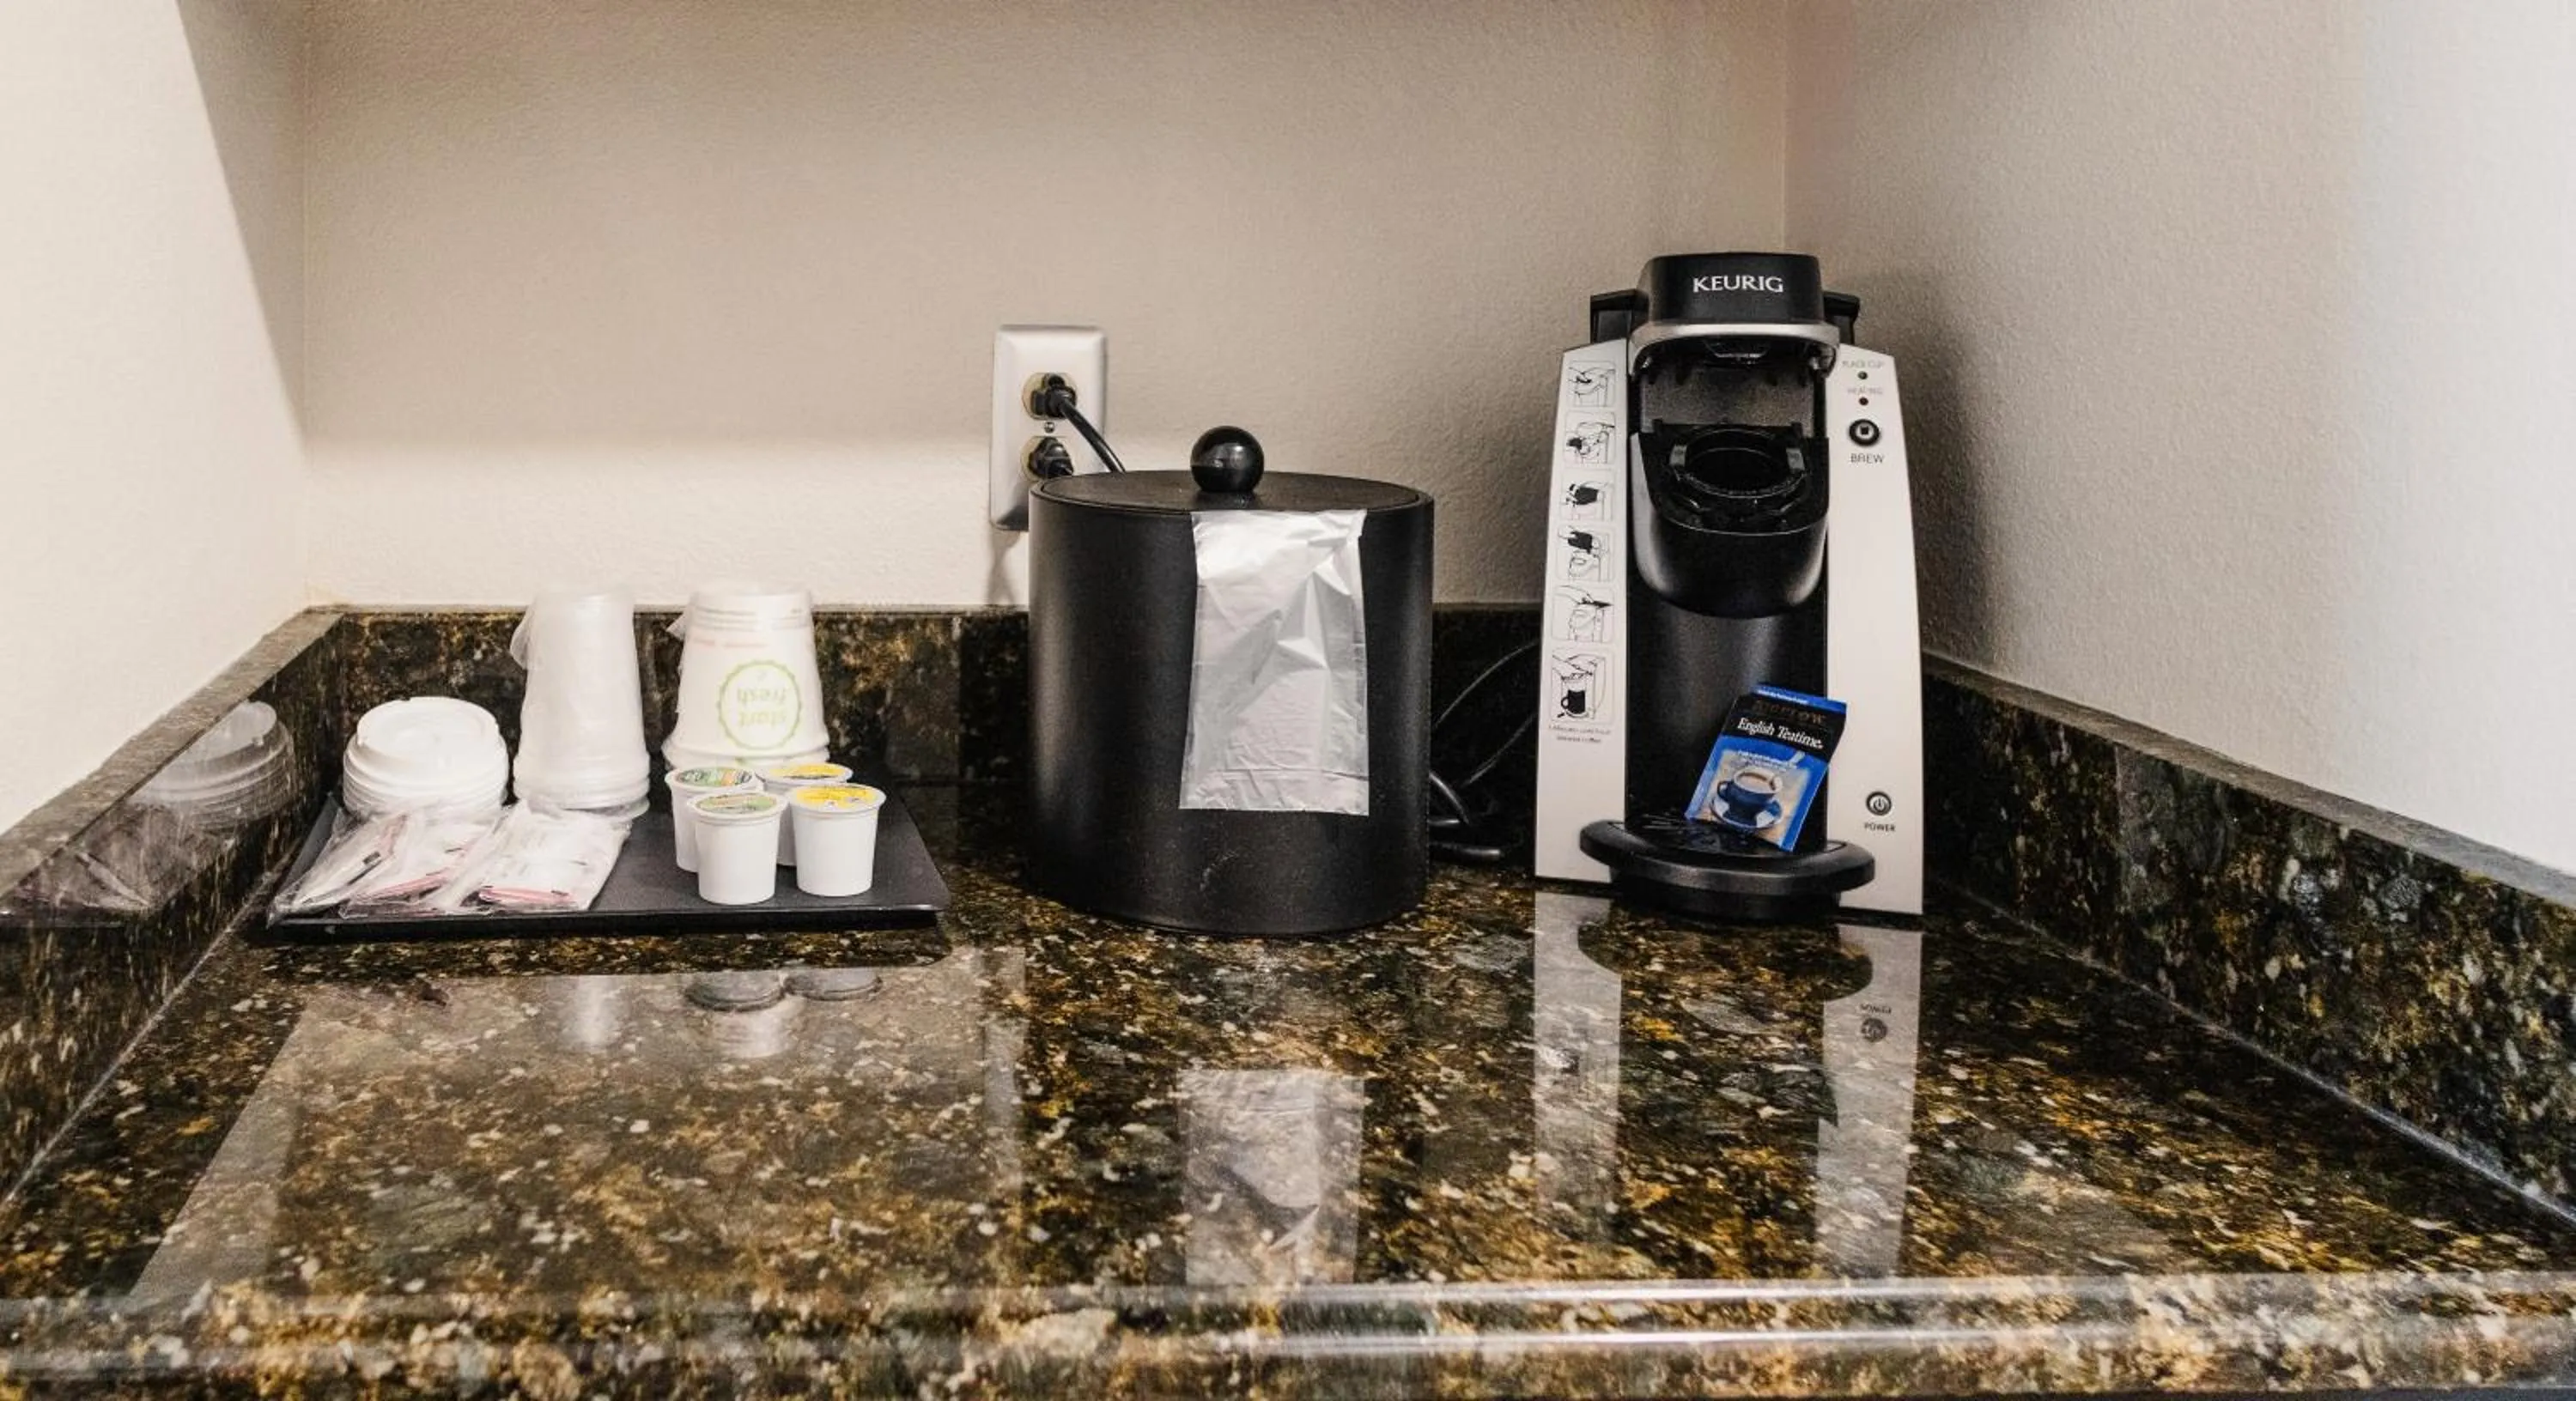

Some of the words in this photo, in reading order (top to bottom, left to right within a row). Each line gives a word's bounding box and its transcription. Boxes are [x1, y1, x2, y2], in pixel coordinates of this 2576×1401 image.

[1692, 274, 1783, 293] KEURIG
[1850, 452, 1884, 464] BREW
[1737, 717, 1776, 736] English
[1863, 822, 1896, 833] POWER
